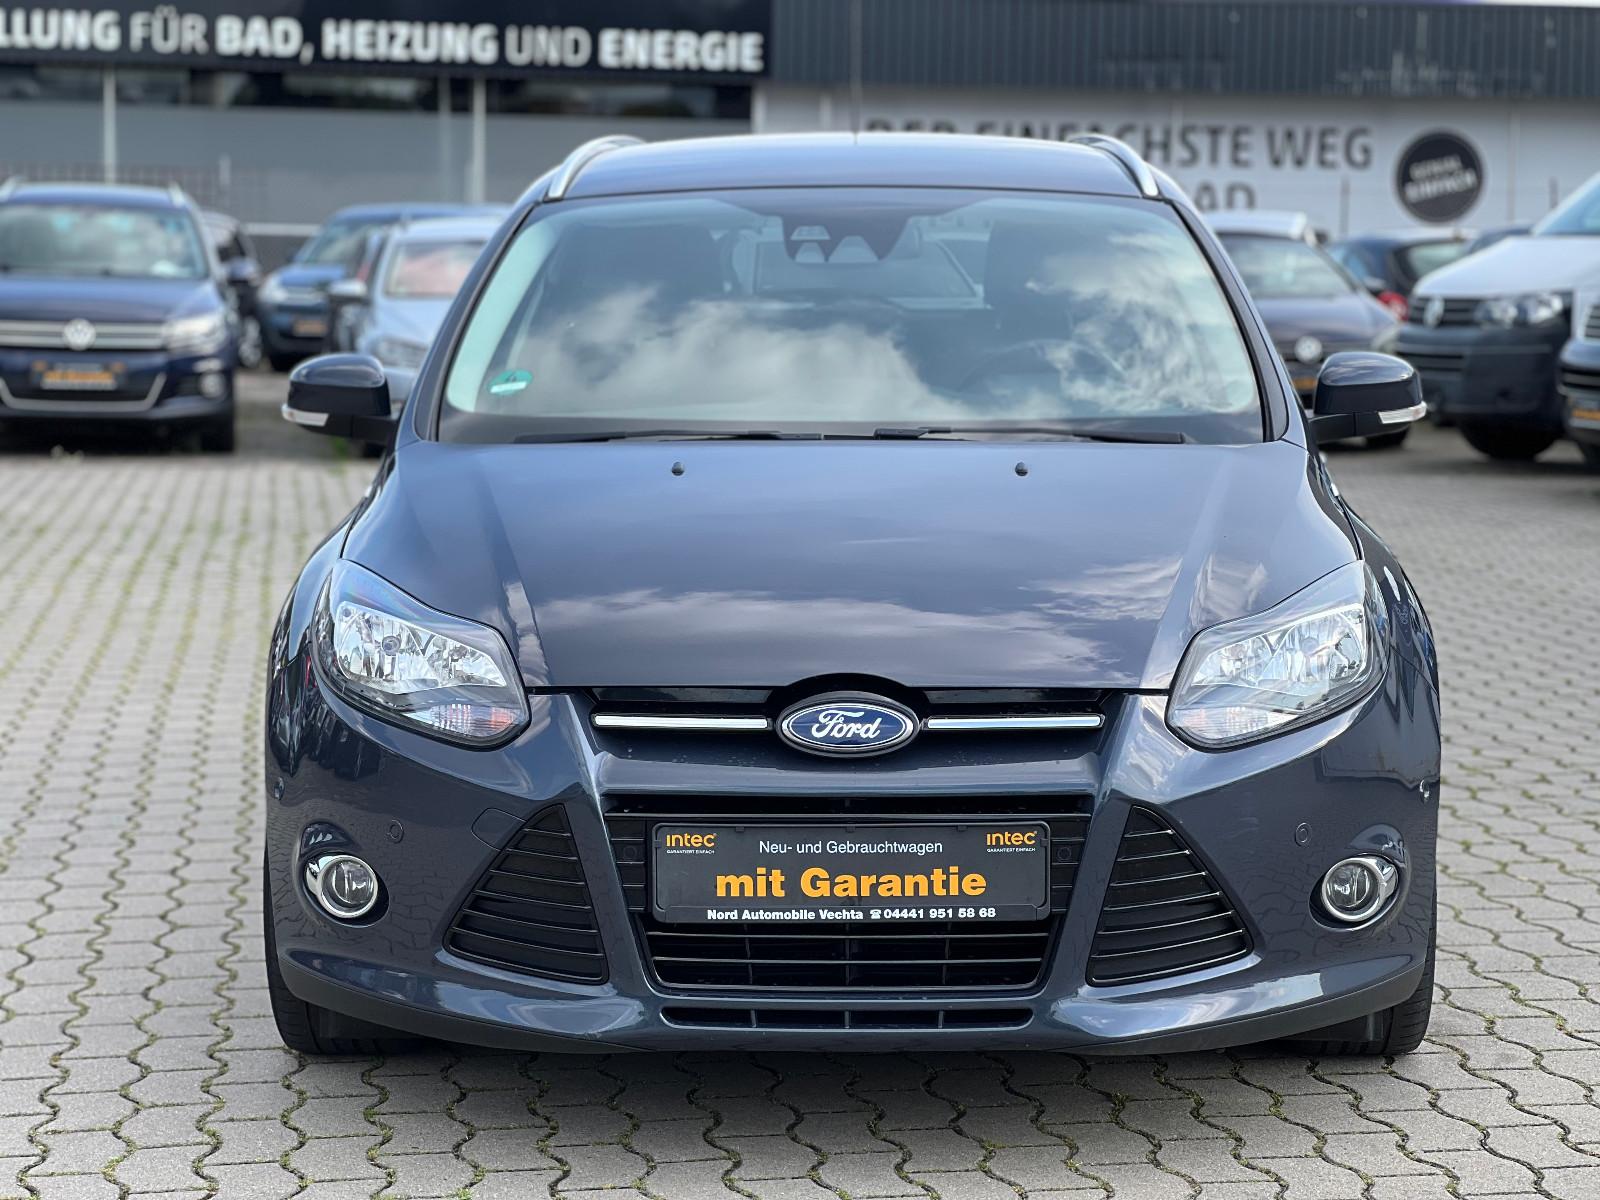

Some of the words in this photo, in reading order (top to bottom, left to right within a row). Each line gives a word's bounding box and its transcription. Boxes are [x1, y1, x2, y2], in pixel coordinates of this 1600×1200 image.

[129, 5, 209, 54] FÜR
[214, 15, 314, 66] BAD,
[321, 17, 499, 66] HEIZUNG
[504, 24, 592, 67] UND
[598, 27, 764, 72] ENERGIE
[1265, 125, 1373, 170] WEG
[811, 709, 883, 739] Ford
[759, 840, 793, 853] Neu-
[796, 840, 822, 853] und
[826, 840, 943, 856] Gebrauchtwagen
[716, 867, 785, 898] mit
[800, 866, 987, 898] Garantie
[707, 909, 738, 920] Nord
[742, 909, 815, 920] Automobile
[819, 909, 863, 920] Vechta
[883, 908, 924, 919] 04441
[929, 908, 952, 919] 951
[957, 908, 975, 918] 58
[978, 907, 997, 918] 68
